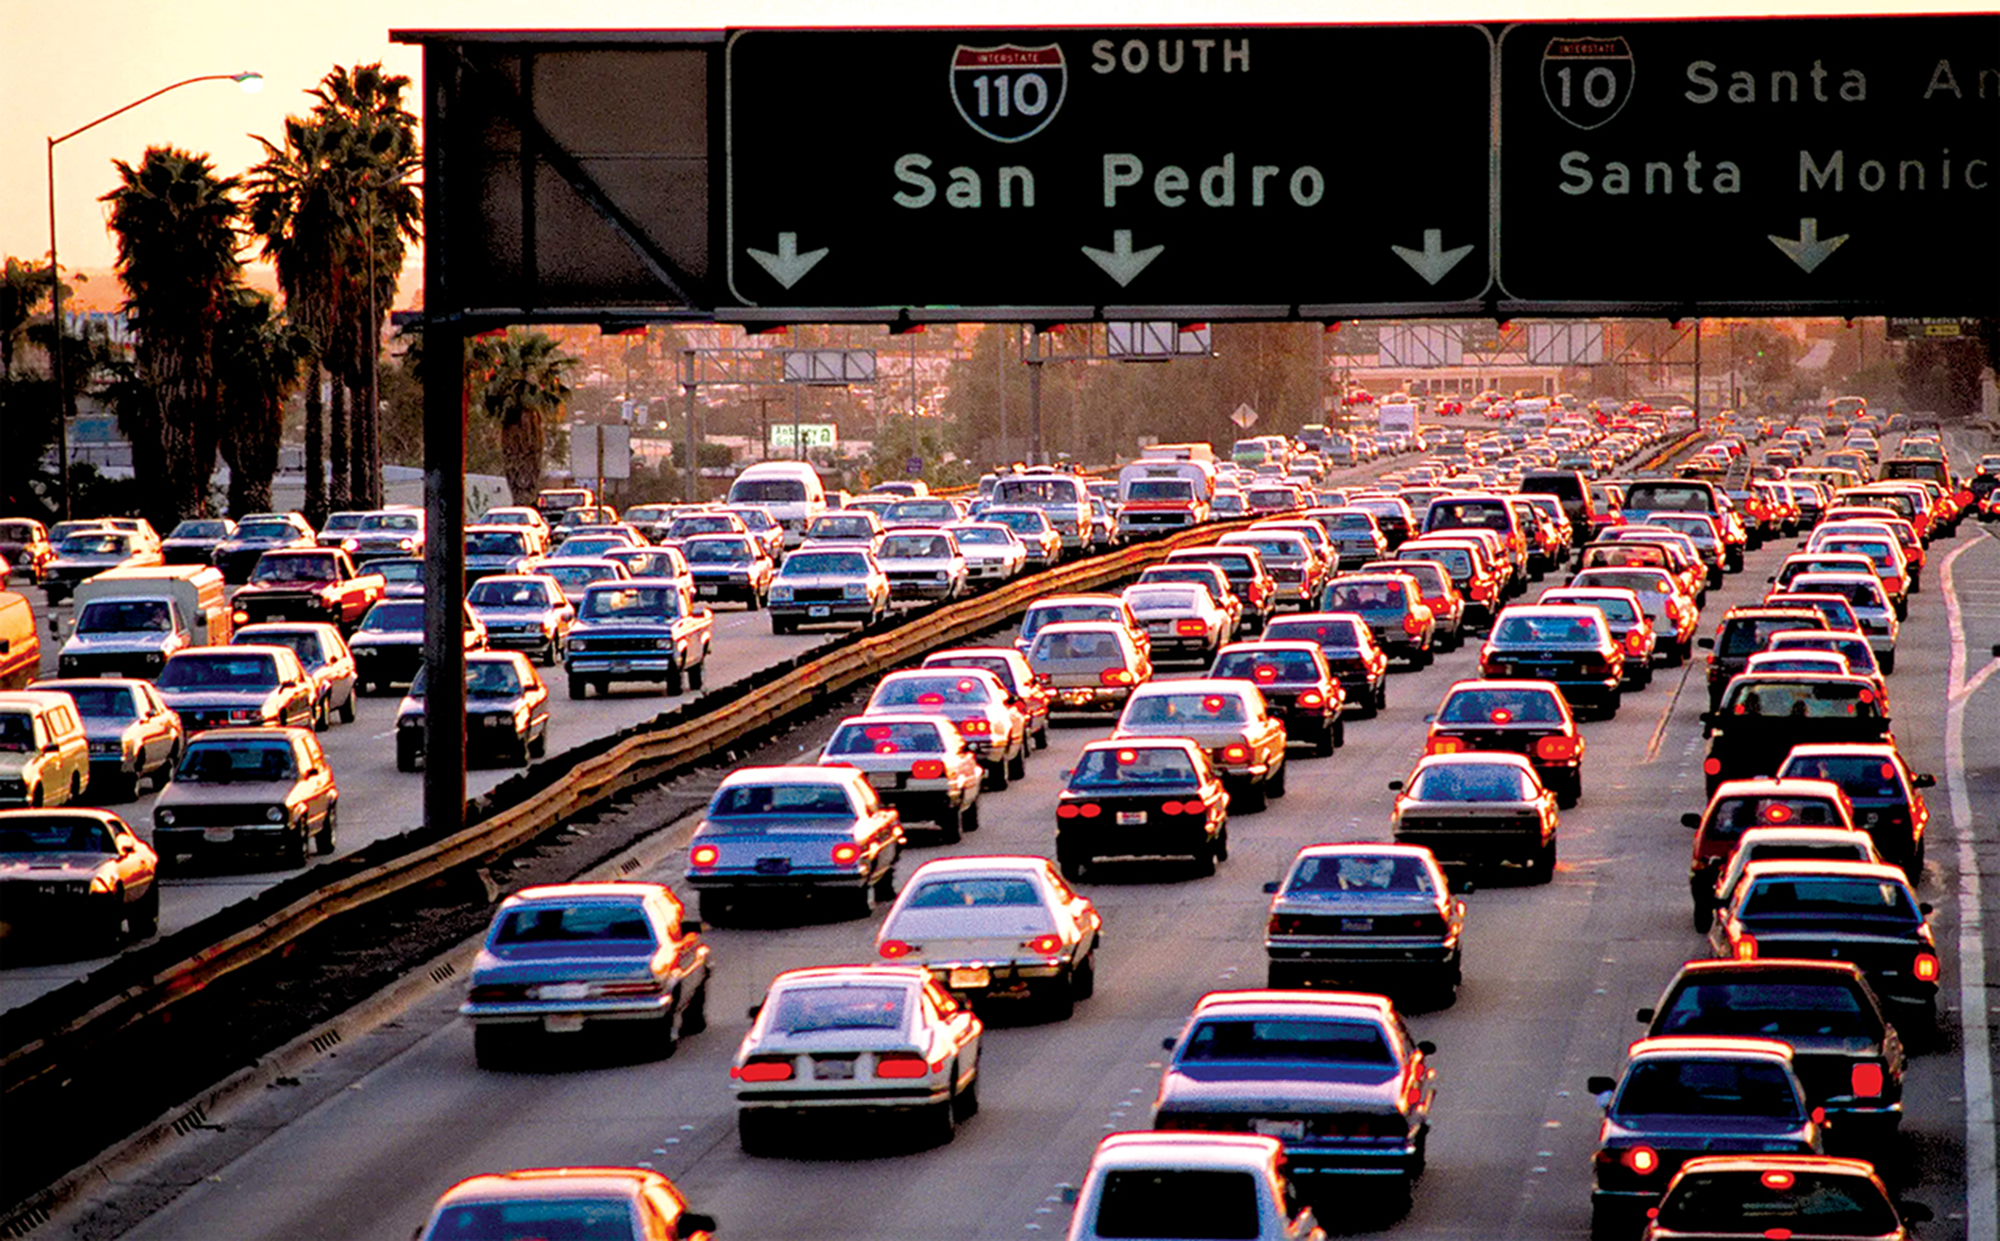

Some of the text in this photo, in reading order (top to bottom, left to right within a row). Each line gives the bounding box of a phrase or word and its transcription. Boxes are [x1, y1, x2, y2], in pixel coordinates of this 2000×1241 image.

[977, 53, 1039, 63] INTERSTATE
[1091, 39, 1249, 74] SOUTH
[1559, 43, 1615, 54] INTERSTATE
[973, 72, 1048, 117] 110
[1557, 66, 1617, 108] 10
[1684, 59, 1867, 104] Santa
[893, 152, 1325, 209] San Pedro
[1558, 148, 1988, 196] Santa Monic
